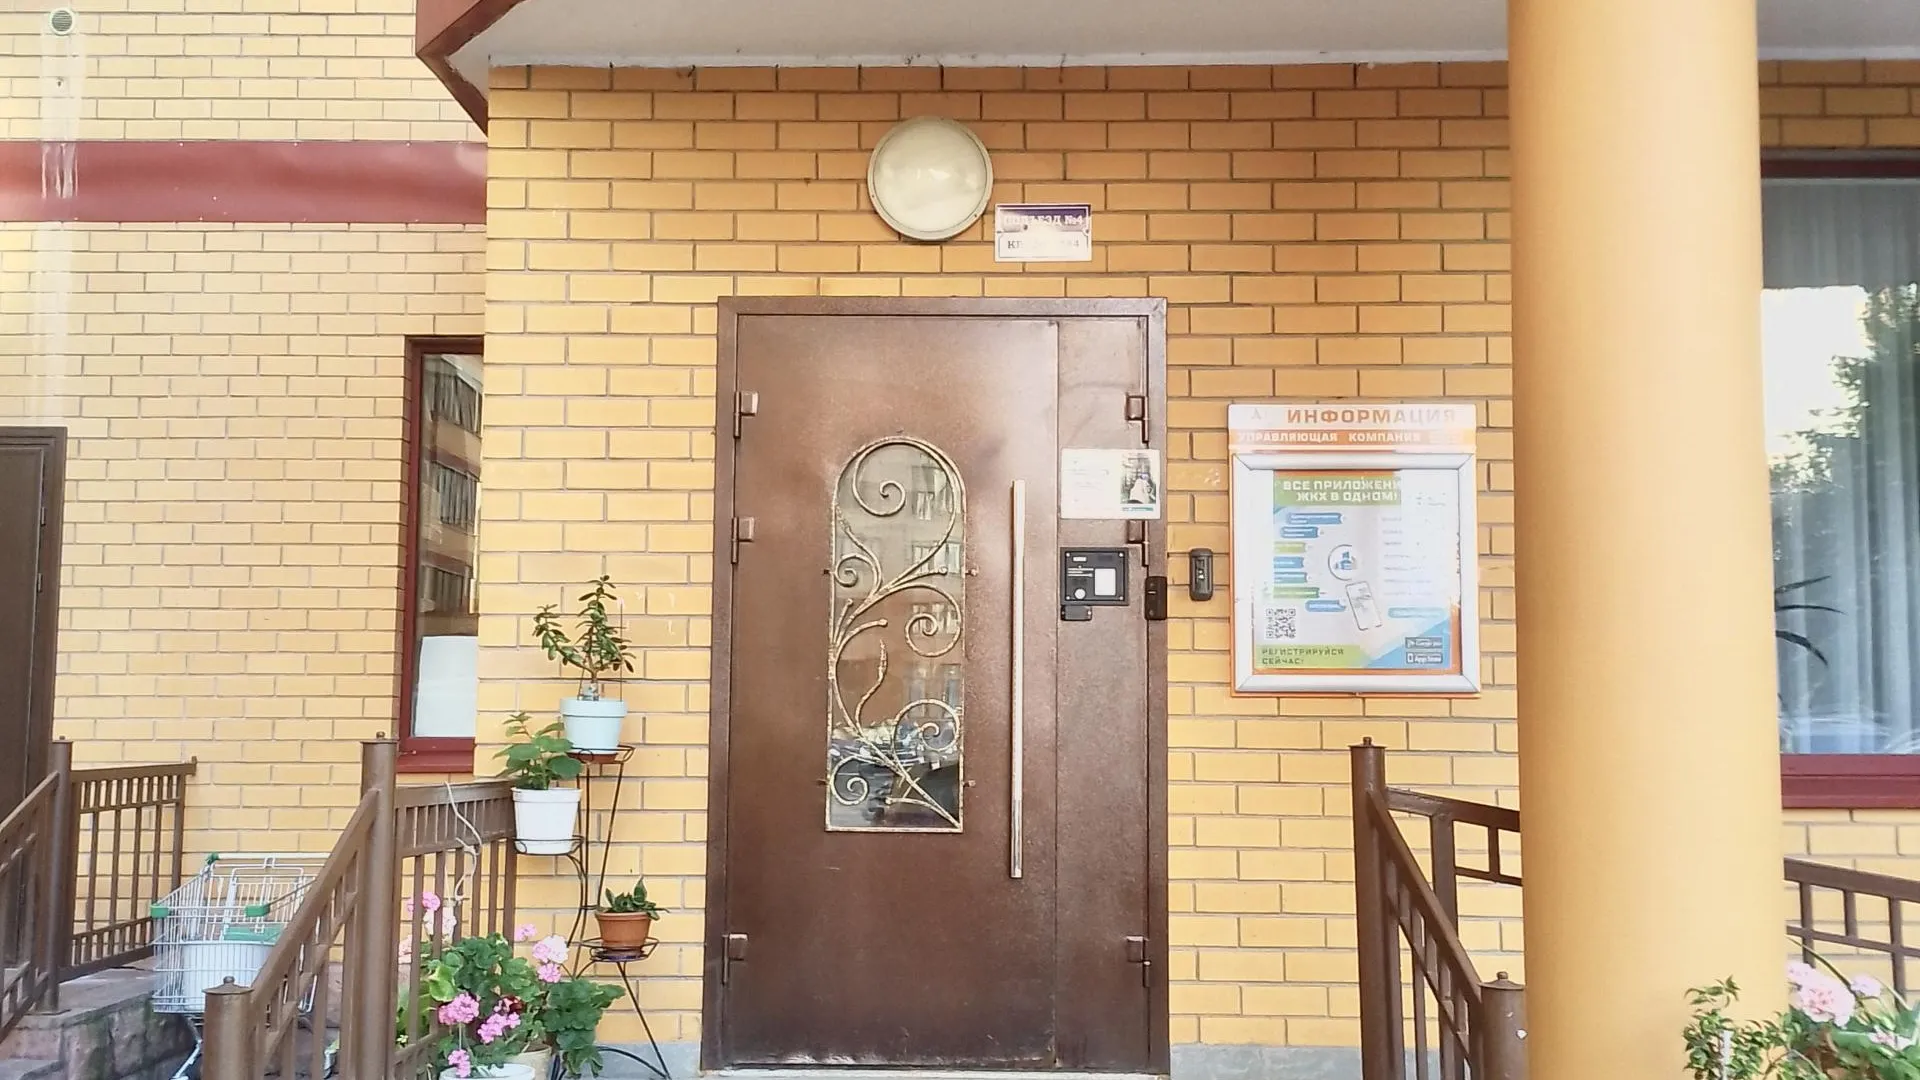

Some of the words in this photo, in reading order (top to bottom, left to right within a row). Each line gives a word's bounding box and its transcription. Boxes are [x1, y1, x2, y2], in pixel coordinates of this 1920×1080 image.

[1287, 409, 1456, 424] ИНФОРМАЦИЯ
[1239, 431, 1338, 443] УПРАВЛЯЮЩАЯ
[1348, 431, 1421, 442] КОМПАНИЯ
[1283, 480, 1310, 490] ВСЕ
[1296, 491, 1327, 501] ЖКХ
[1330, 491, 1339, 501] В
[1262, 647, 1344, 656] РЕГИСТРИРУЙСЯ
